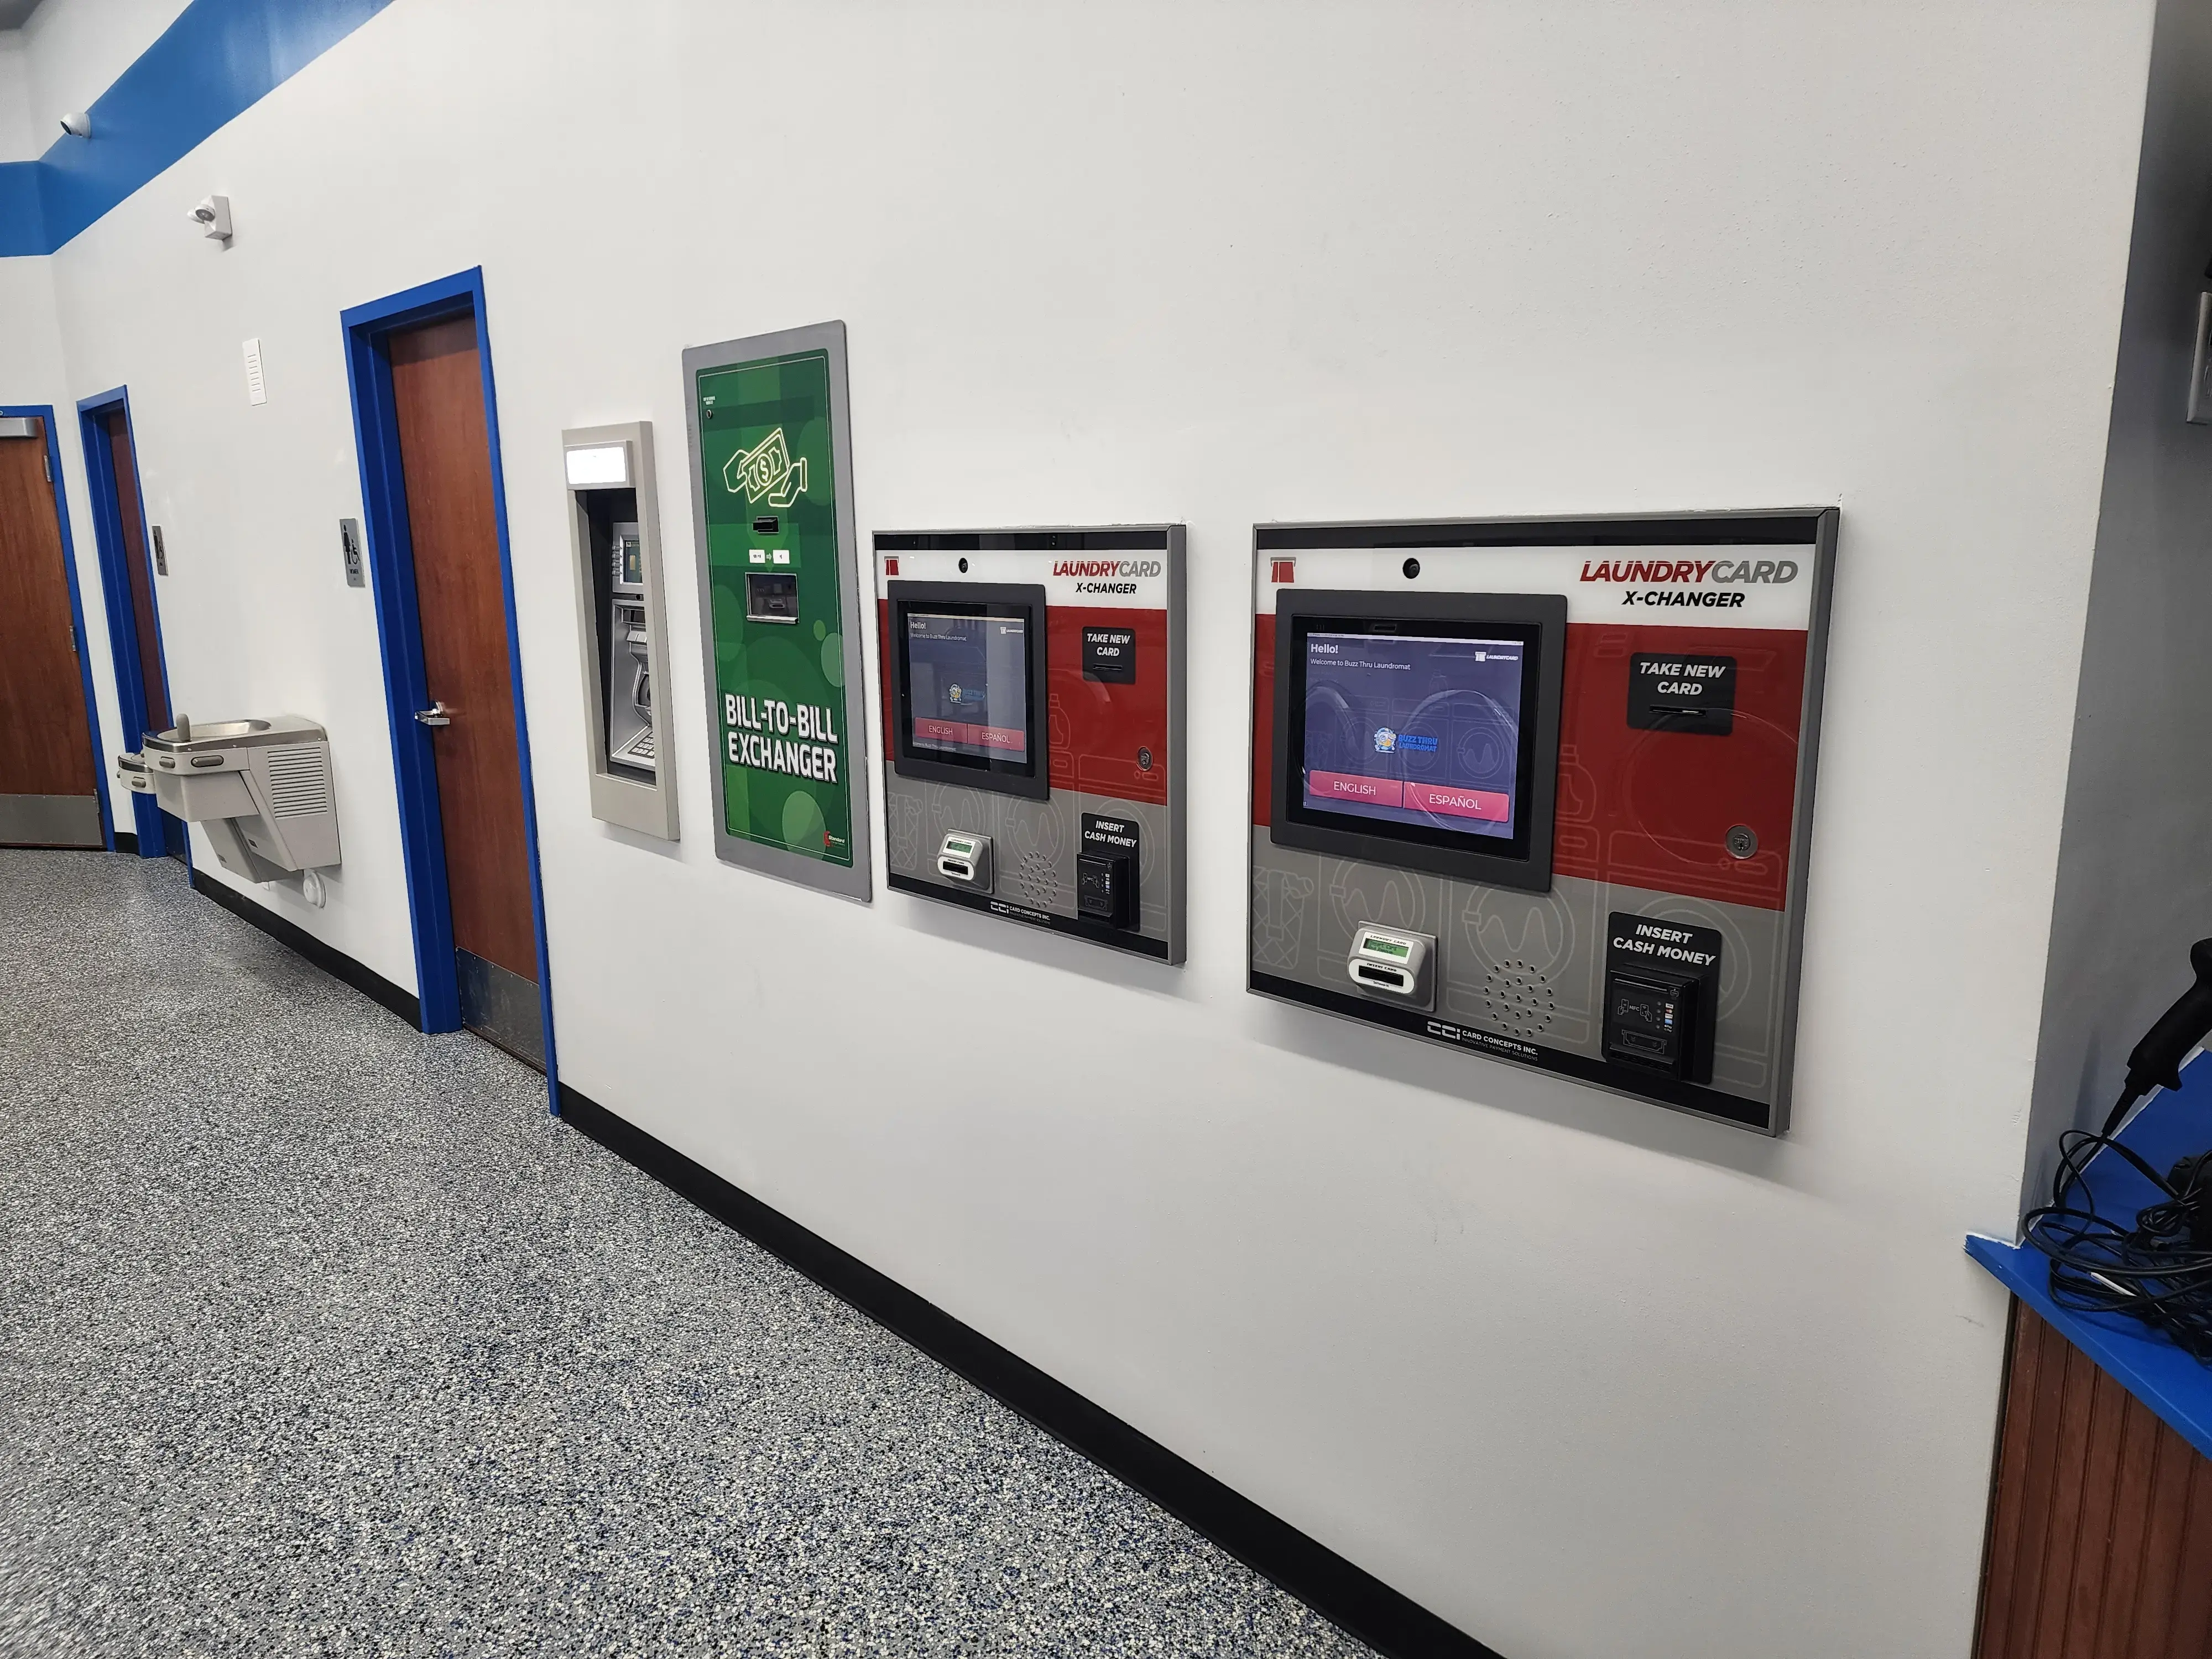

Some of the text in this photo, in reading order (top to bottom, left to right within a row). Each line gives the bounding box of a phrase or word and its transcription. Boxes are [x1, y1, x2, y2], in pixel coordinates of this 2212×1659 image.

[1053, 561, 1161, 577] LAUNDRYCARD
[1579, 560, 1798, 583] LAUNDRYCARD
[1076, 582, 1136, 594] X-CHANGER
[1622, 591, 1745, 608] X-CHANGER
[1087, 633, 1130, 644] TAKE NEW
[1097, 646, 1120, 656] CARD
[1311, 644, 1338, 654] Hello!
[1374, 661, 1411, 670] Laundromat
[1640, 662, 1726, 678] TAKE NEW
[1657, 681, 1703, 695] CARD
[725, 692, 838, 743] BILL-TO-BILL
[928, 725, 953, 735] ENGLISH
[982, 732, 1011, 743] ESPAÑOL
[1398, 734, 1438, 745] BUZZ THRU
[728, 731, 837, 784] EXCHANGER
[1333, 781, 1376, 796] ENGLISH
[1429, 794, 1481, 810] ESPAÑOL
[1095, 820, 1124, 833] INSERT
[1084, 831, 1137, 847] CASH MONEY
[1021, 909, 1041, 918] CONCEPTS
[1636, 924, 1693, 943] INSERT
[1613, 937, 1716, 966] CASH MONEY
[1462, 1037, 1538, 1061] INNOVATIVE PAYMENT SOLUTIONS
[1463, 1030, 1538, 1056] CARD CONCEPTS INC.
